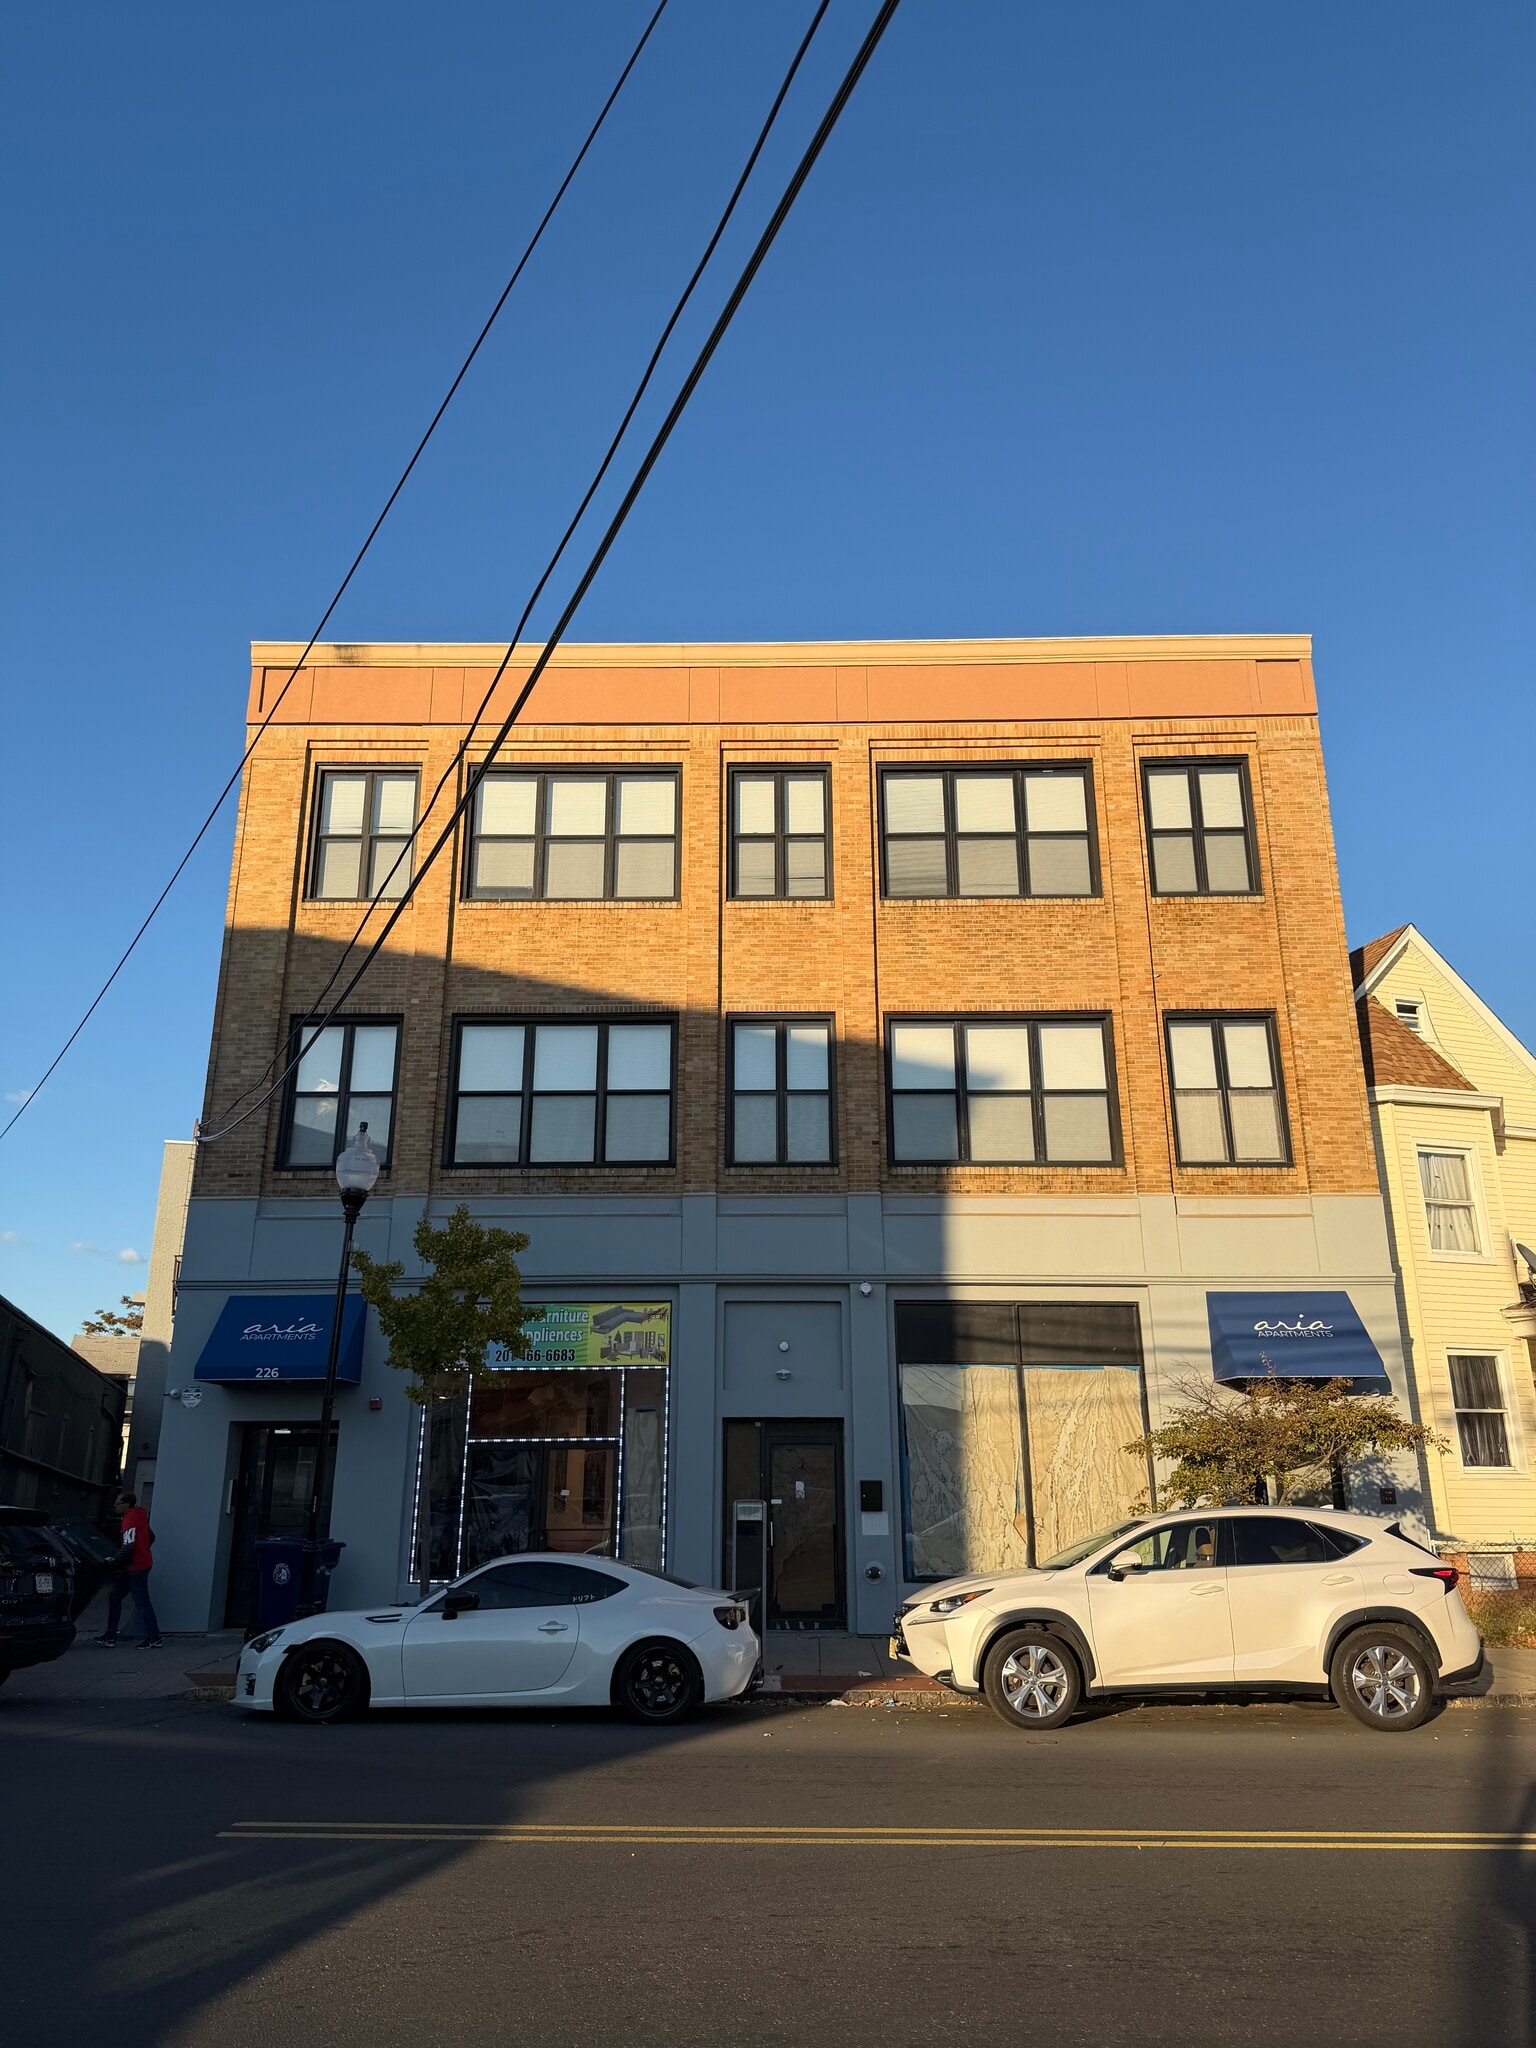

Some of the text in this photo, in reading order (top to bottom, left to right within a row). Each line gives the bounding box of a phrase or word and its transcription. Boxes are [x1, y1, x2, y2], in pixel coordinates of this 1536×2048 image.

[531, 1309, 588, 1323] rniture
[1254, 1313, 1333, 1330] aria
[243, 1317, 323, 1333] aria
[240, 1332, 316, 1341] APARTMENTS
[1257, 1330, 1334, 1338] APARTMENTS
[255, 1367, 279, 1378] 226
